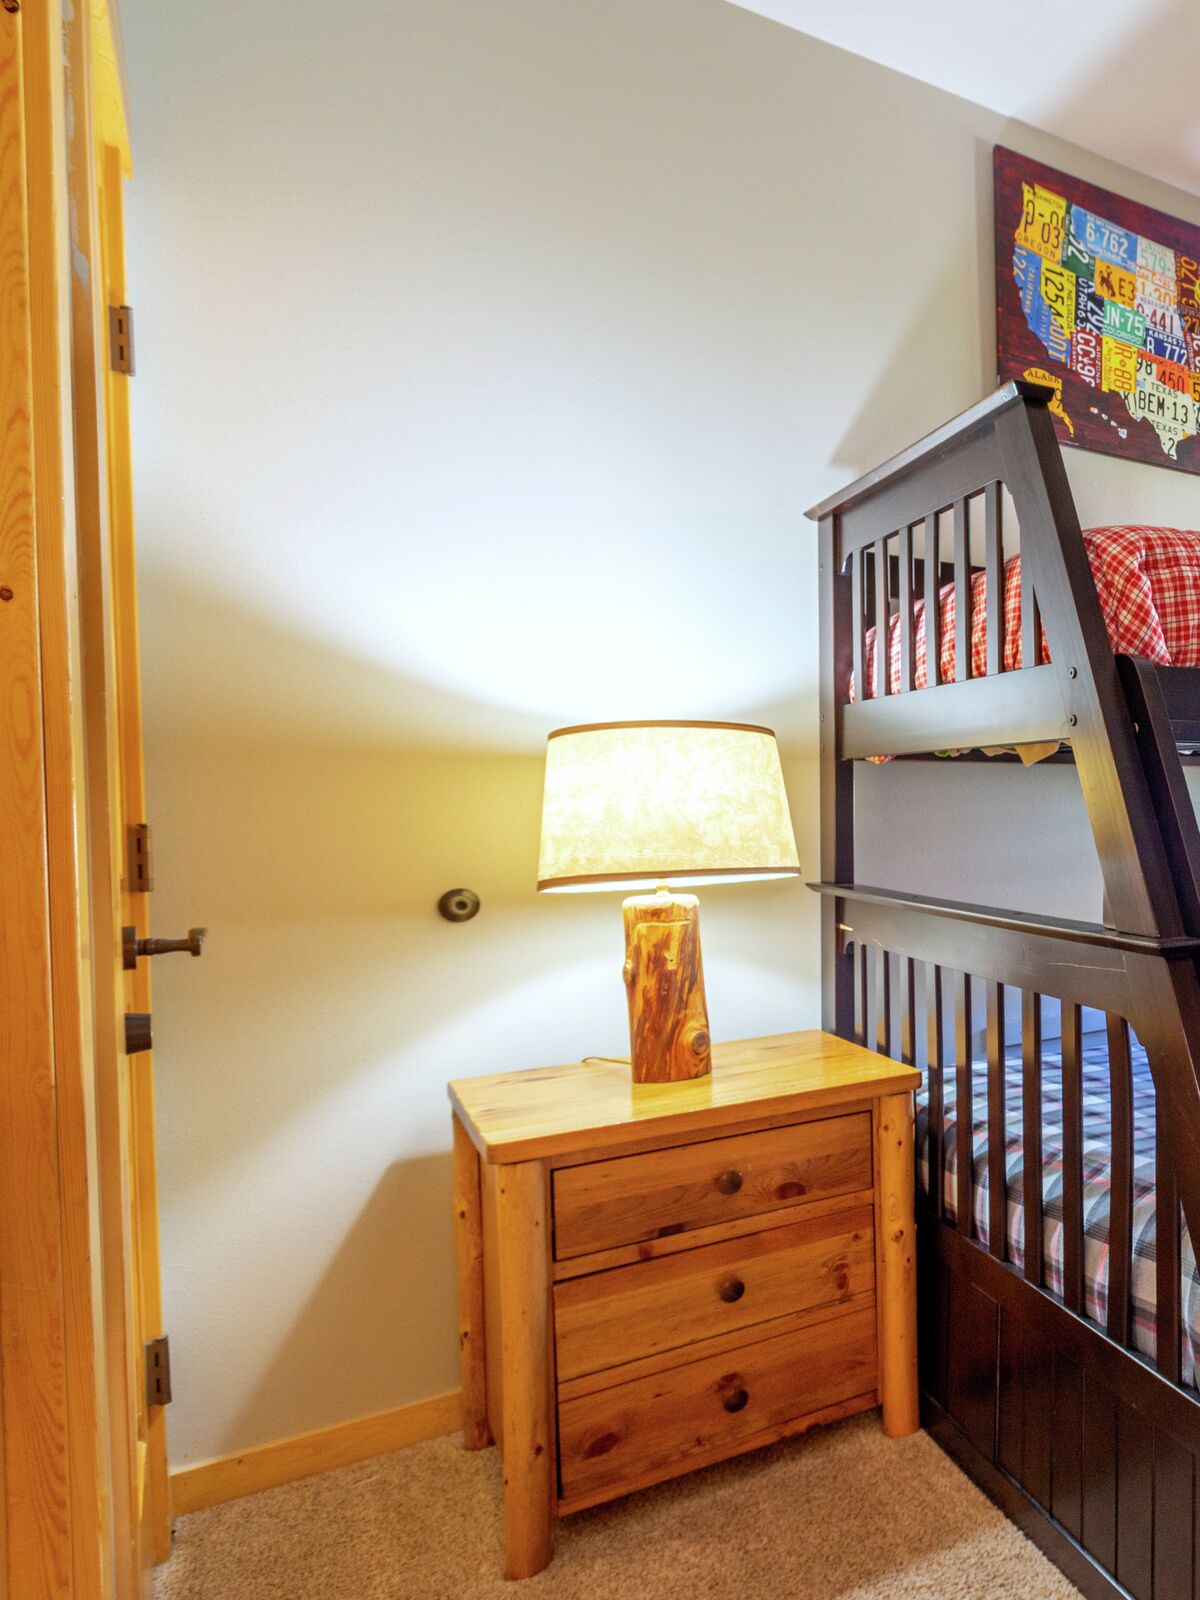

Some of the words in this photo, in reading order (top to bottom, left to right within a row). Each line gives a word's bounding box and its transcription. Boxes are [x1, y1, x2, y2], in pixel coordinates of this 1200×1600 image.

[1016, 231, 1057, 259] OREGON
[1078, 277, 1089, 309] UTAH
[1103, 325, 1141, 344] COLORADO
[1148, 329, 1177, 344] KANSAS
[1185, 332, 1195, 372] MISSOURI
[1151, 382, 1179, 399] TEXAS
[1152, 420, 1179, 436] TEXAS
